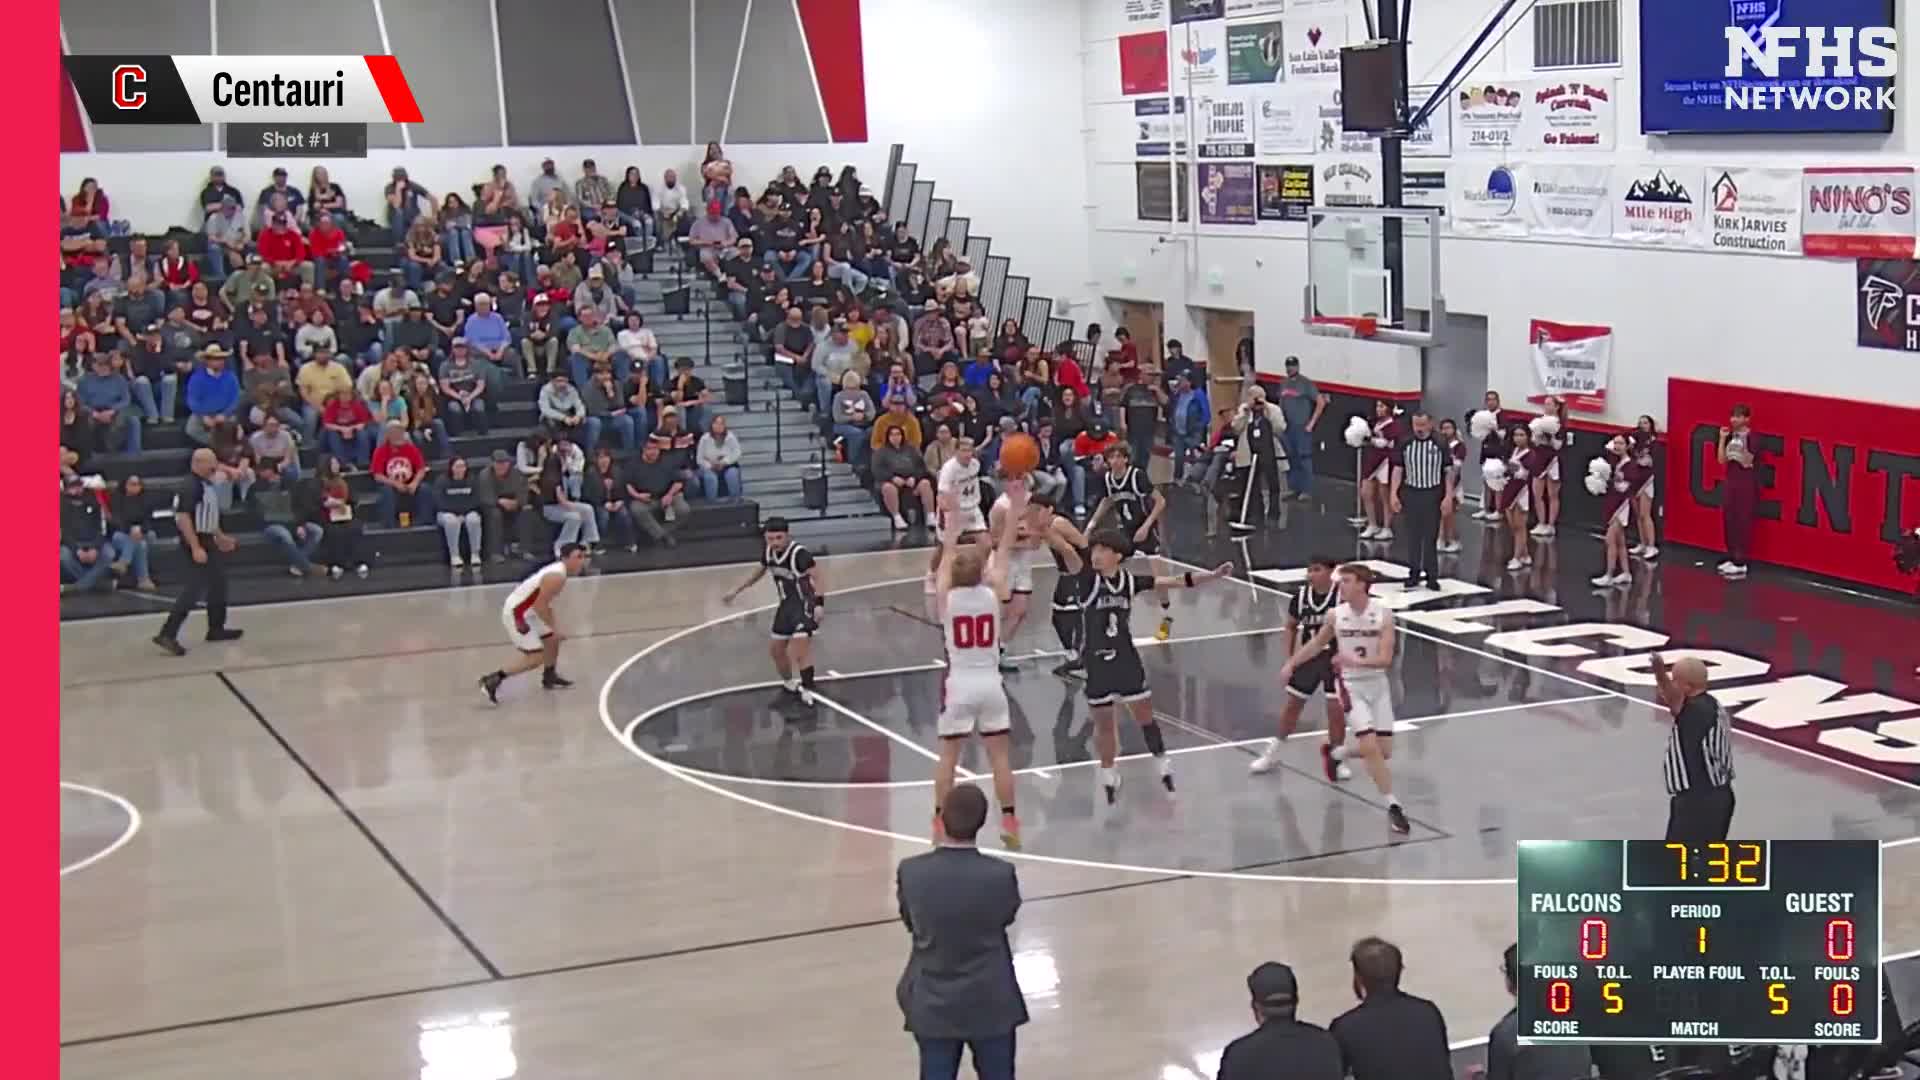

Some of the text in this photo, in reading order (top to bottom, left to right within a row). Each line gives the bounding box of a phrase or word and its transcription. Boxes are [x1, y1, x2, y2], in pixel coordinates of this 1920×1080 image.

[1319, 49, 1340, 60] Valle
[1543, 133, 1558, 144] Go
[1809, 183, 1912, 215] NINO'S
[1625, 206, 1692, 223] Mile High
[1714, 215, 1787, 233] KIRK JARVIES
[1713, 233, 1786, 250] Construction
[952, 612, 994, 649] 00
